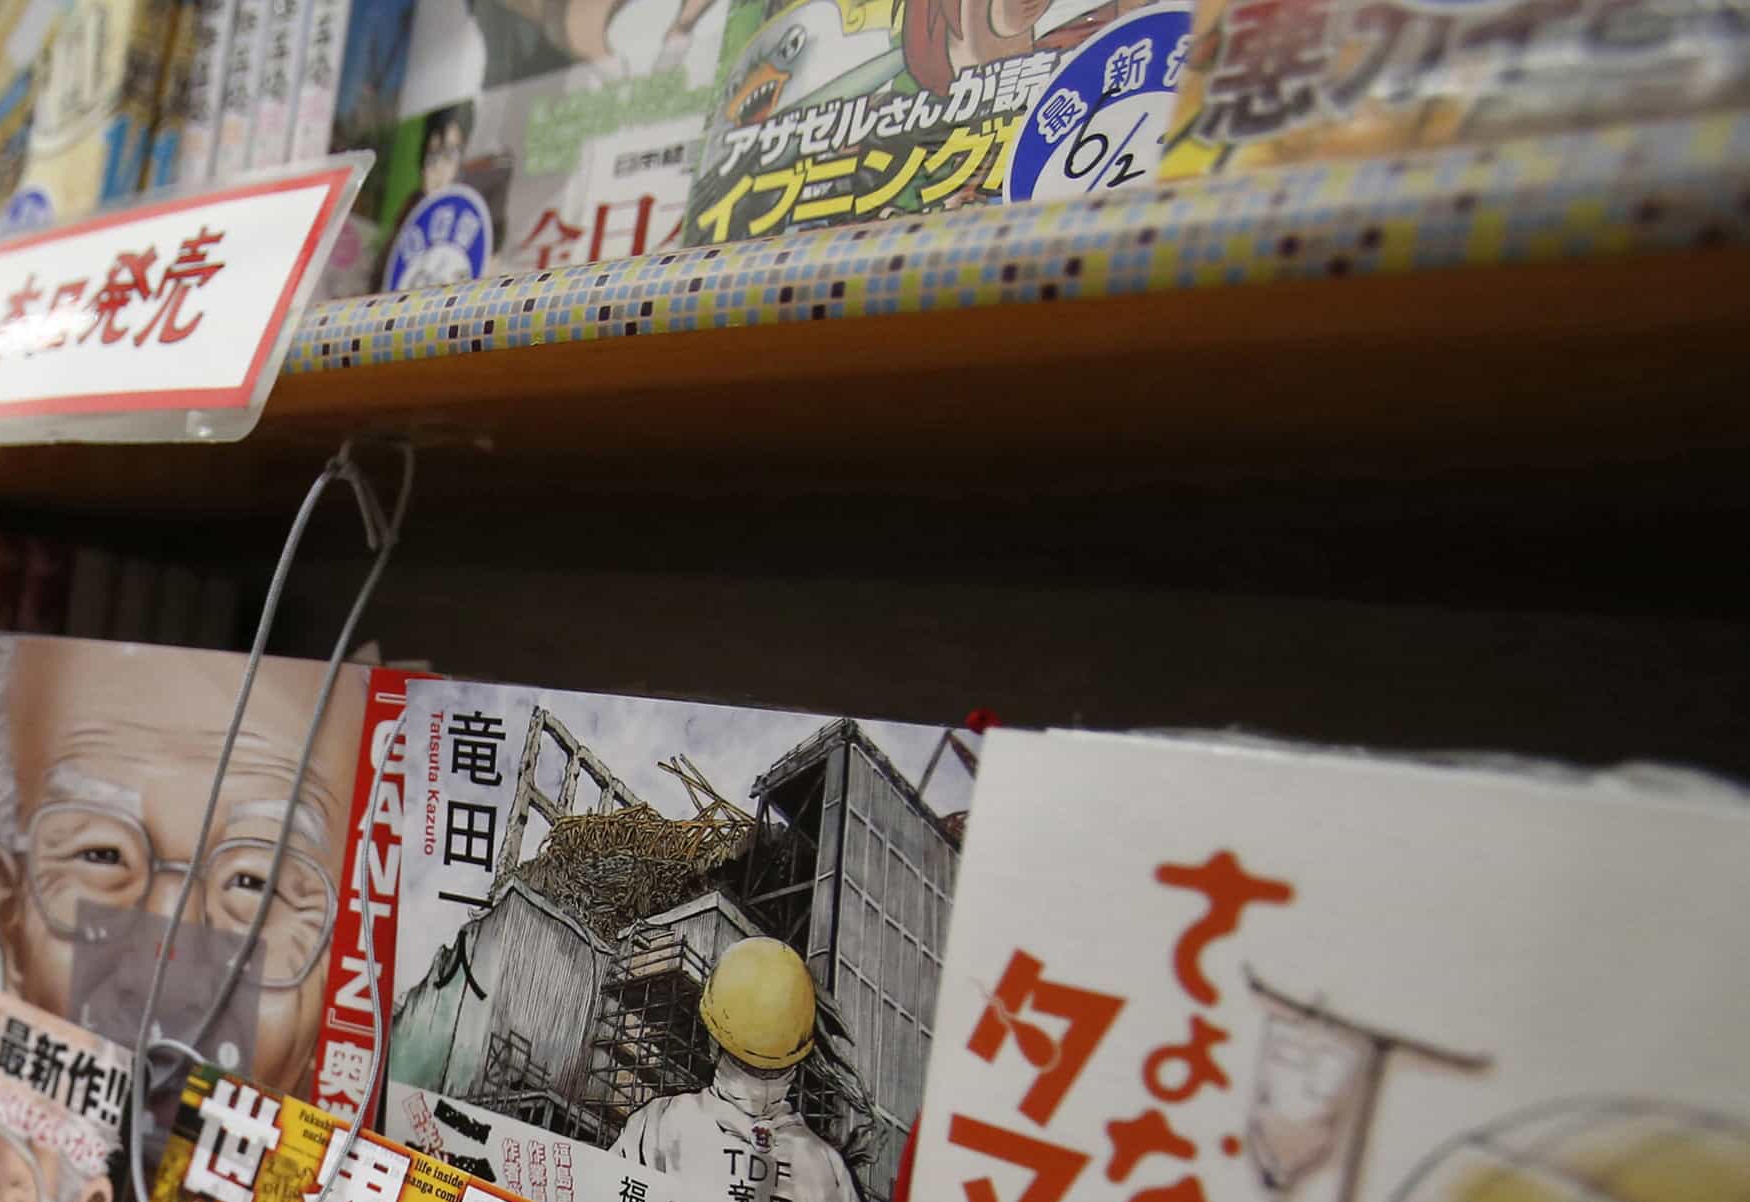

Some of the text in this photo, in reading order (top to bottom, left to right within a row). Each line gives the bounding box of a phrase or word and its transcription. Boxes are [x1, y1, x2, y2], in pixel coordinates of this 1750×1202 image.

[423, 710, 445, 856] Tatsuta Kazuto
[433, 711, 507, 1001] 竜田一人
[414, 1158, 464, 1190] life inside
[723, 1148, 791, 1188] TDF
